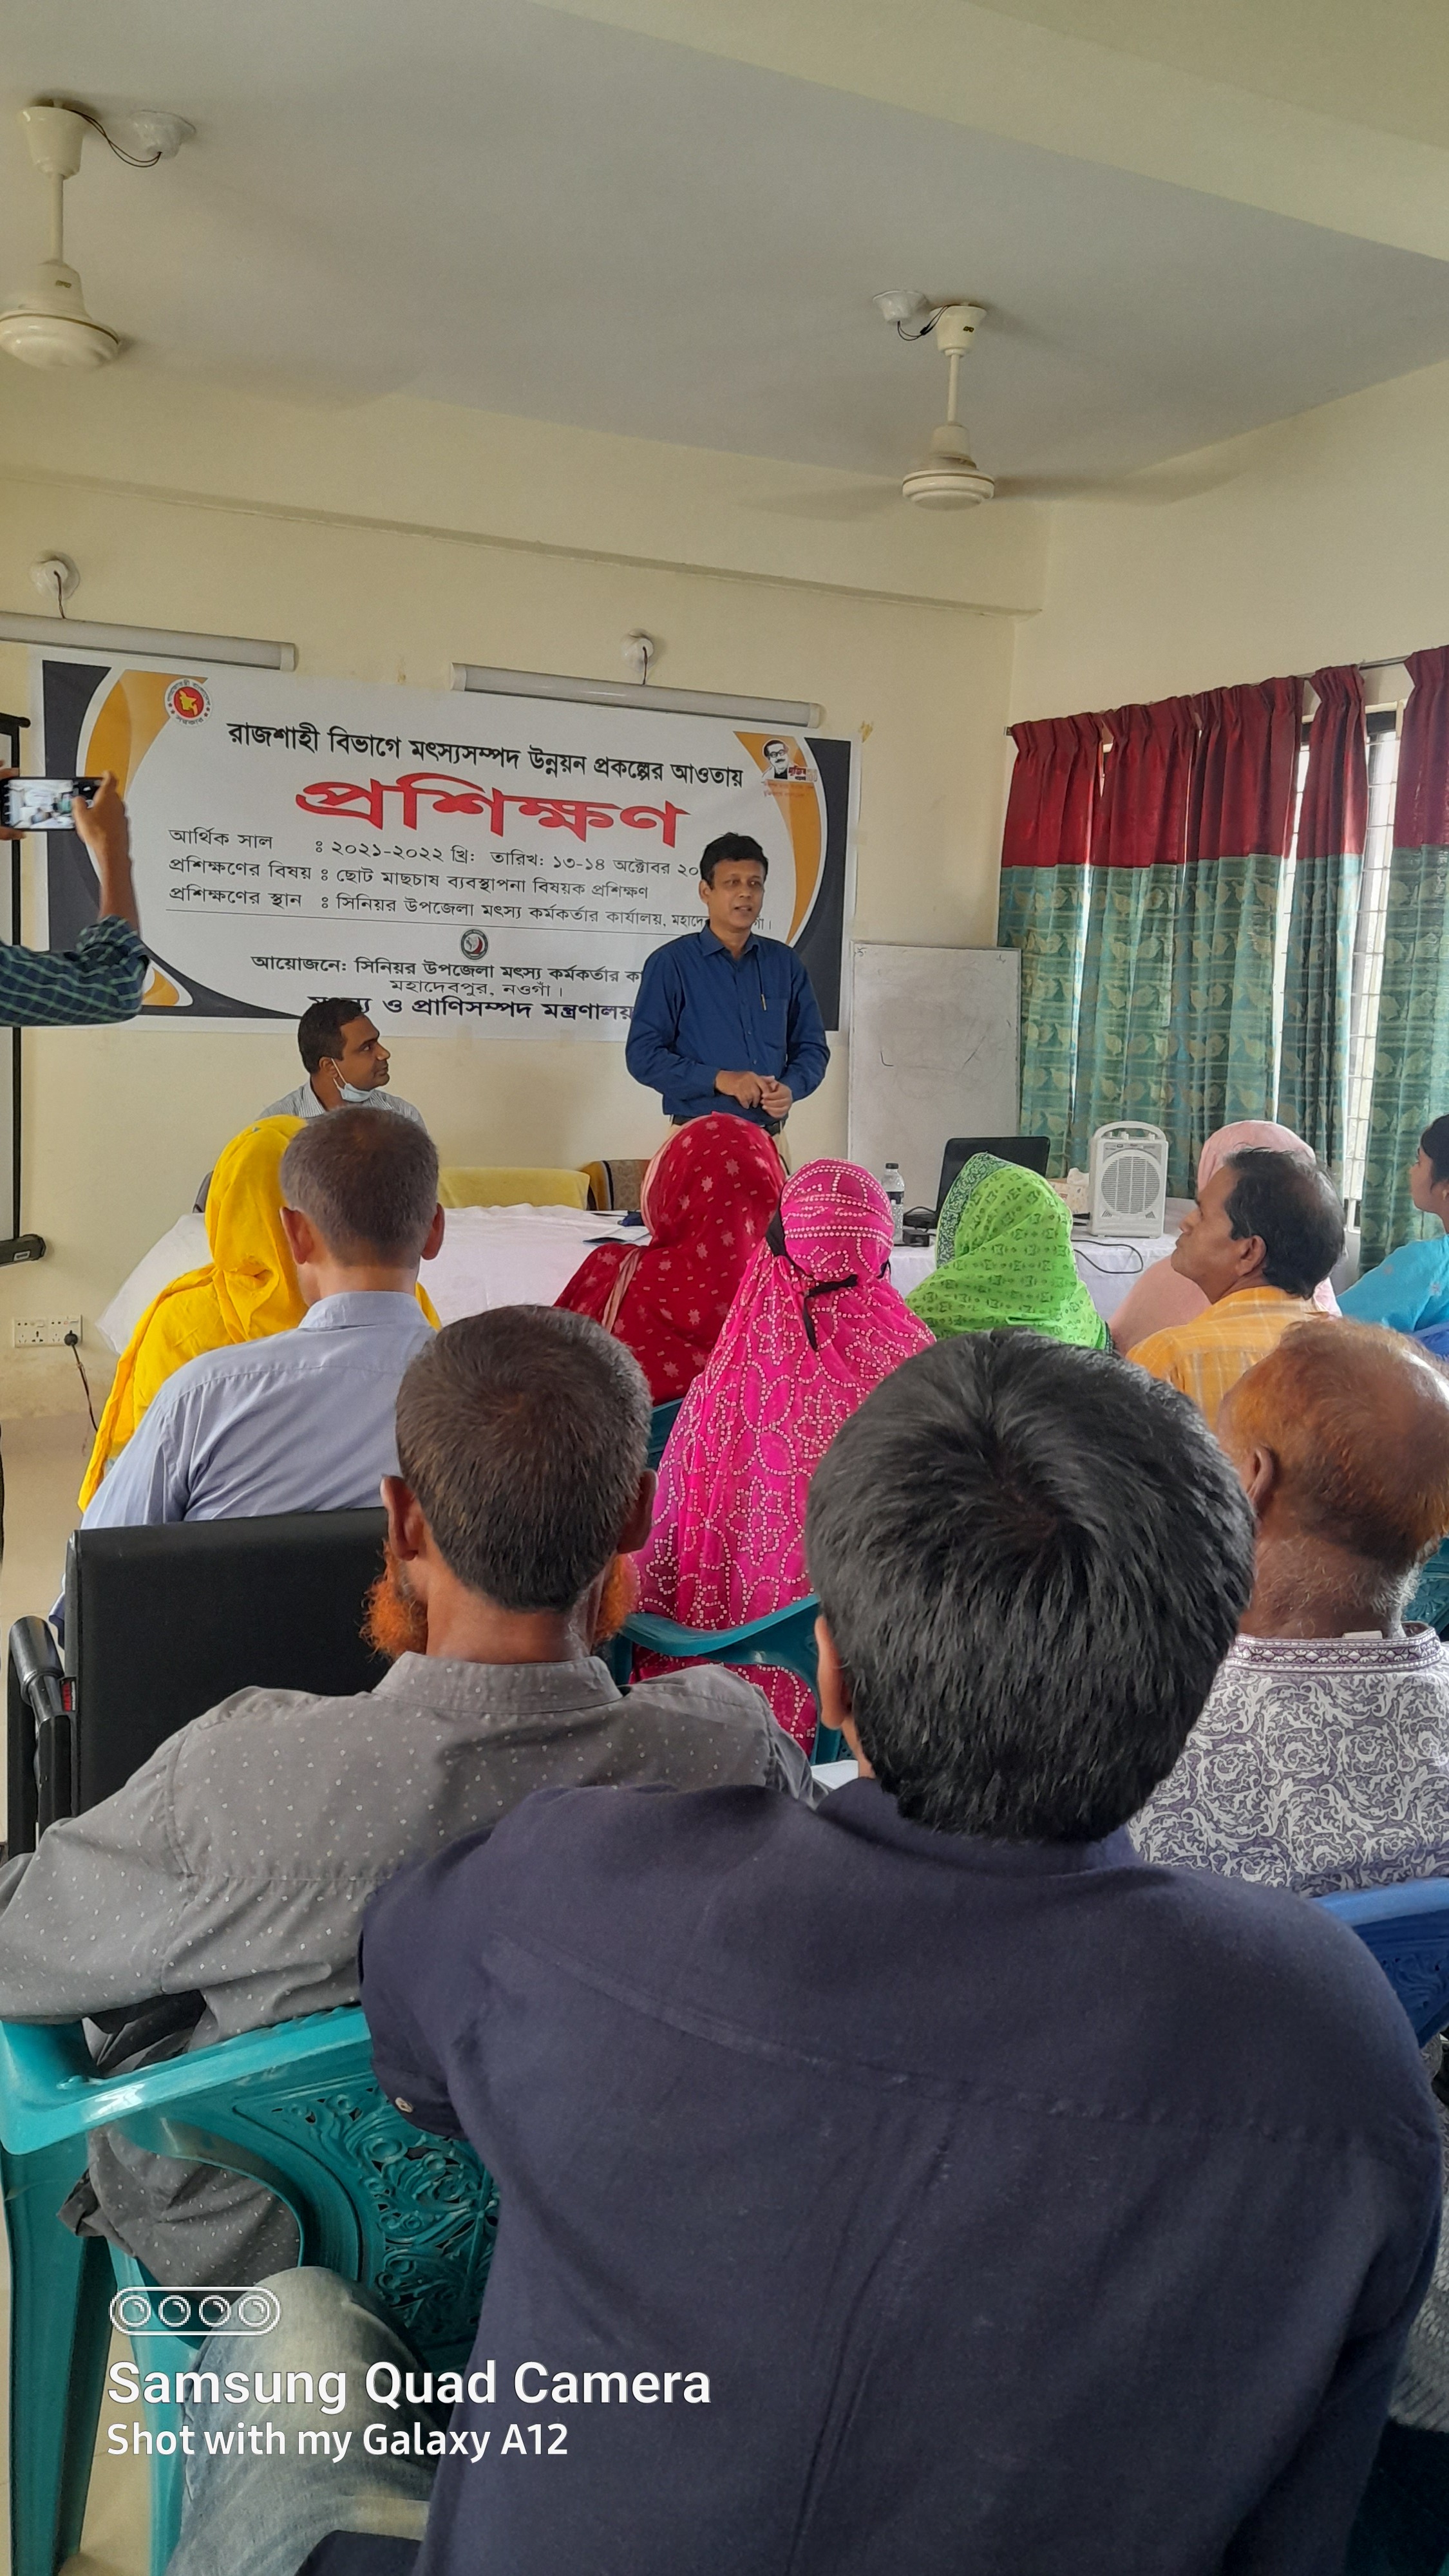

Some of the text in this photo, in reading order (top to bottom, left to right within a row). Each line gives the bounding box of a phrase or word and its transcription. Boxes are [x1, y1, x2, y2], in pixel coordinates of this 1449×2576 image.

[226, 722, 743, 788] রাজশাহী বিভাগে মৎস্যসম্পদ উন্নয়ন প্রকল্পের আওতায়
[296, 772, 690, 848] প্রশিক্ষণ
[168, 827, 229, 846] আর্থিক
[237, 835, 273, 850] সাল
[331, 841, 444, 862] ২০২১-২০২২
[553, 855, 605, 871] ১৩-১৪
[612, 858, 670, 875] অক্টোবর
[169, 855, 260, 877] প্রশিক্ষণের
[268, 860, 312, 880] বিষয়
[337, 866, 374, 884] ছোট
[381, 871, 439, 887] মাছচাষ
[446, 875, 526, 894] ব্যবস্থাপনা
[533, 877, 586, 895] বিষয়ক
[592, 882, 649, 899] প্রশিক্ষণ
[169, 884, 260, 905] প্রশিক্ষণের
[268, 893, 301, 909] স্থান
[336, 892, 397, 913] সিনিয়র
[403, 896, 474, 917] উপজেলা
[481, 904, 522, 920] মৎস্য
[528, 904, 599, 923] কর্মকর্তার
[354, 956, 416, 975] সিনিয়র
[422, 959, 494, 978] উপজেলা
[500, 966, 542, 980] মৎস্য
[547, 965, 620, 982] কর্মকর্তার
[383, 999, 402, 1013] ও
[412, 996, 533, 1018] প্রাণিসম্পদ
